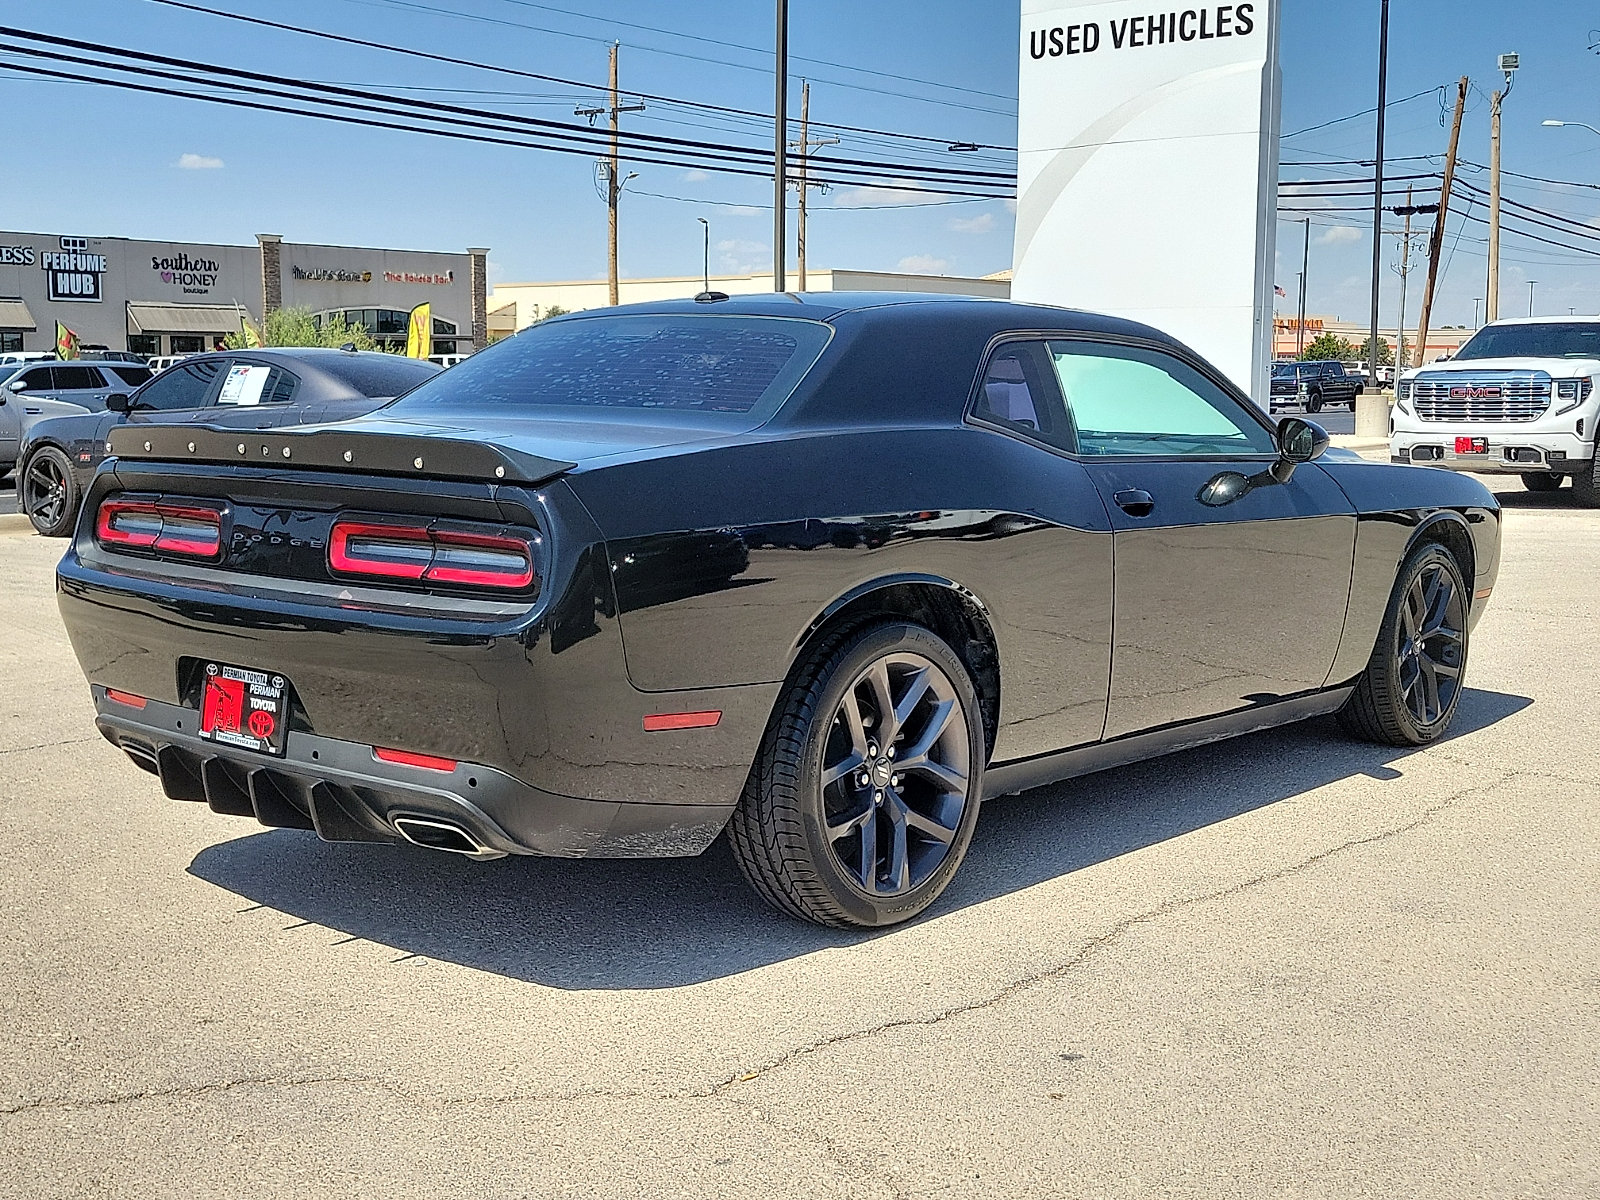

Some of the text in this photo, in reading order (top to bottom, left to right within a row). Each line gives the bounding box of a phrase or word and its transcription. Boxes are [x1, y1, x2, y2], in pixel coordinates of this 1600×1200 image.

[1030, 3, 1254, 60] USED VEHICLES
[0, 247, 35, 265] ESS
[42, 252, 107, 272] PERFUME
[152, 252, 219, 272] southern
[57, 272, 94, 295] HUB
[172, 272, 217, 286] HONEY
[1451, 387, 1501, 398] GMC
[233, 532, 324, 549] DODGE
[224, 667, 267, 685] PERMIAN TOYOTA
[249, 683, 281, 698] PERMIAN
[249, 697, 277, 712] TOYOTA
